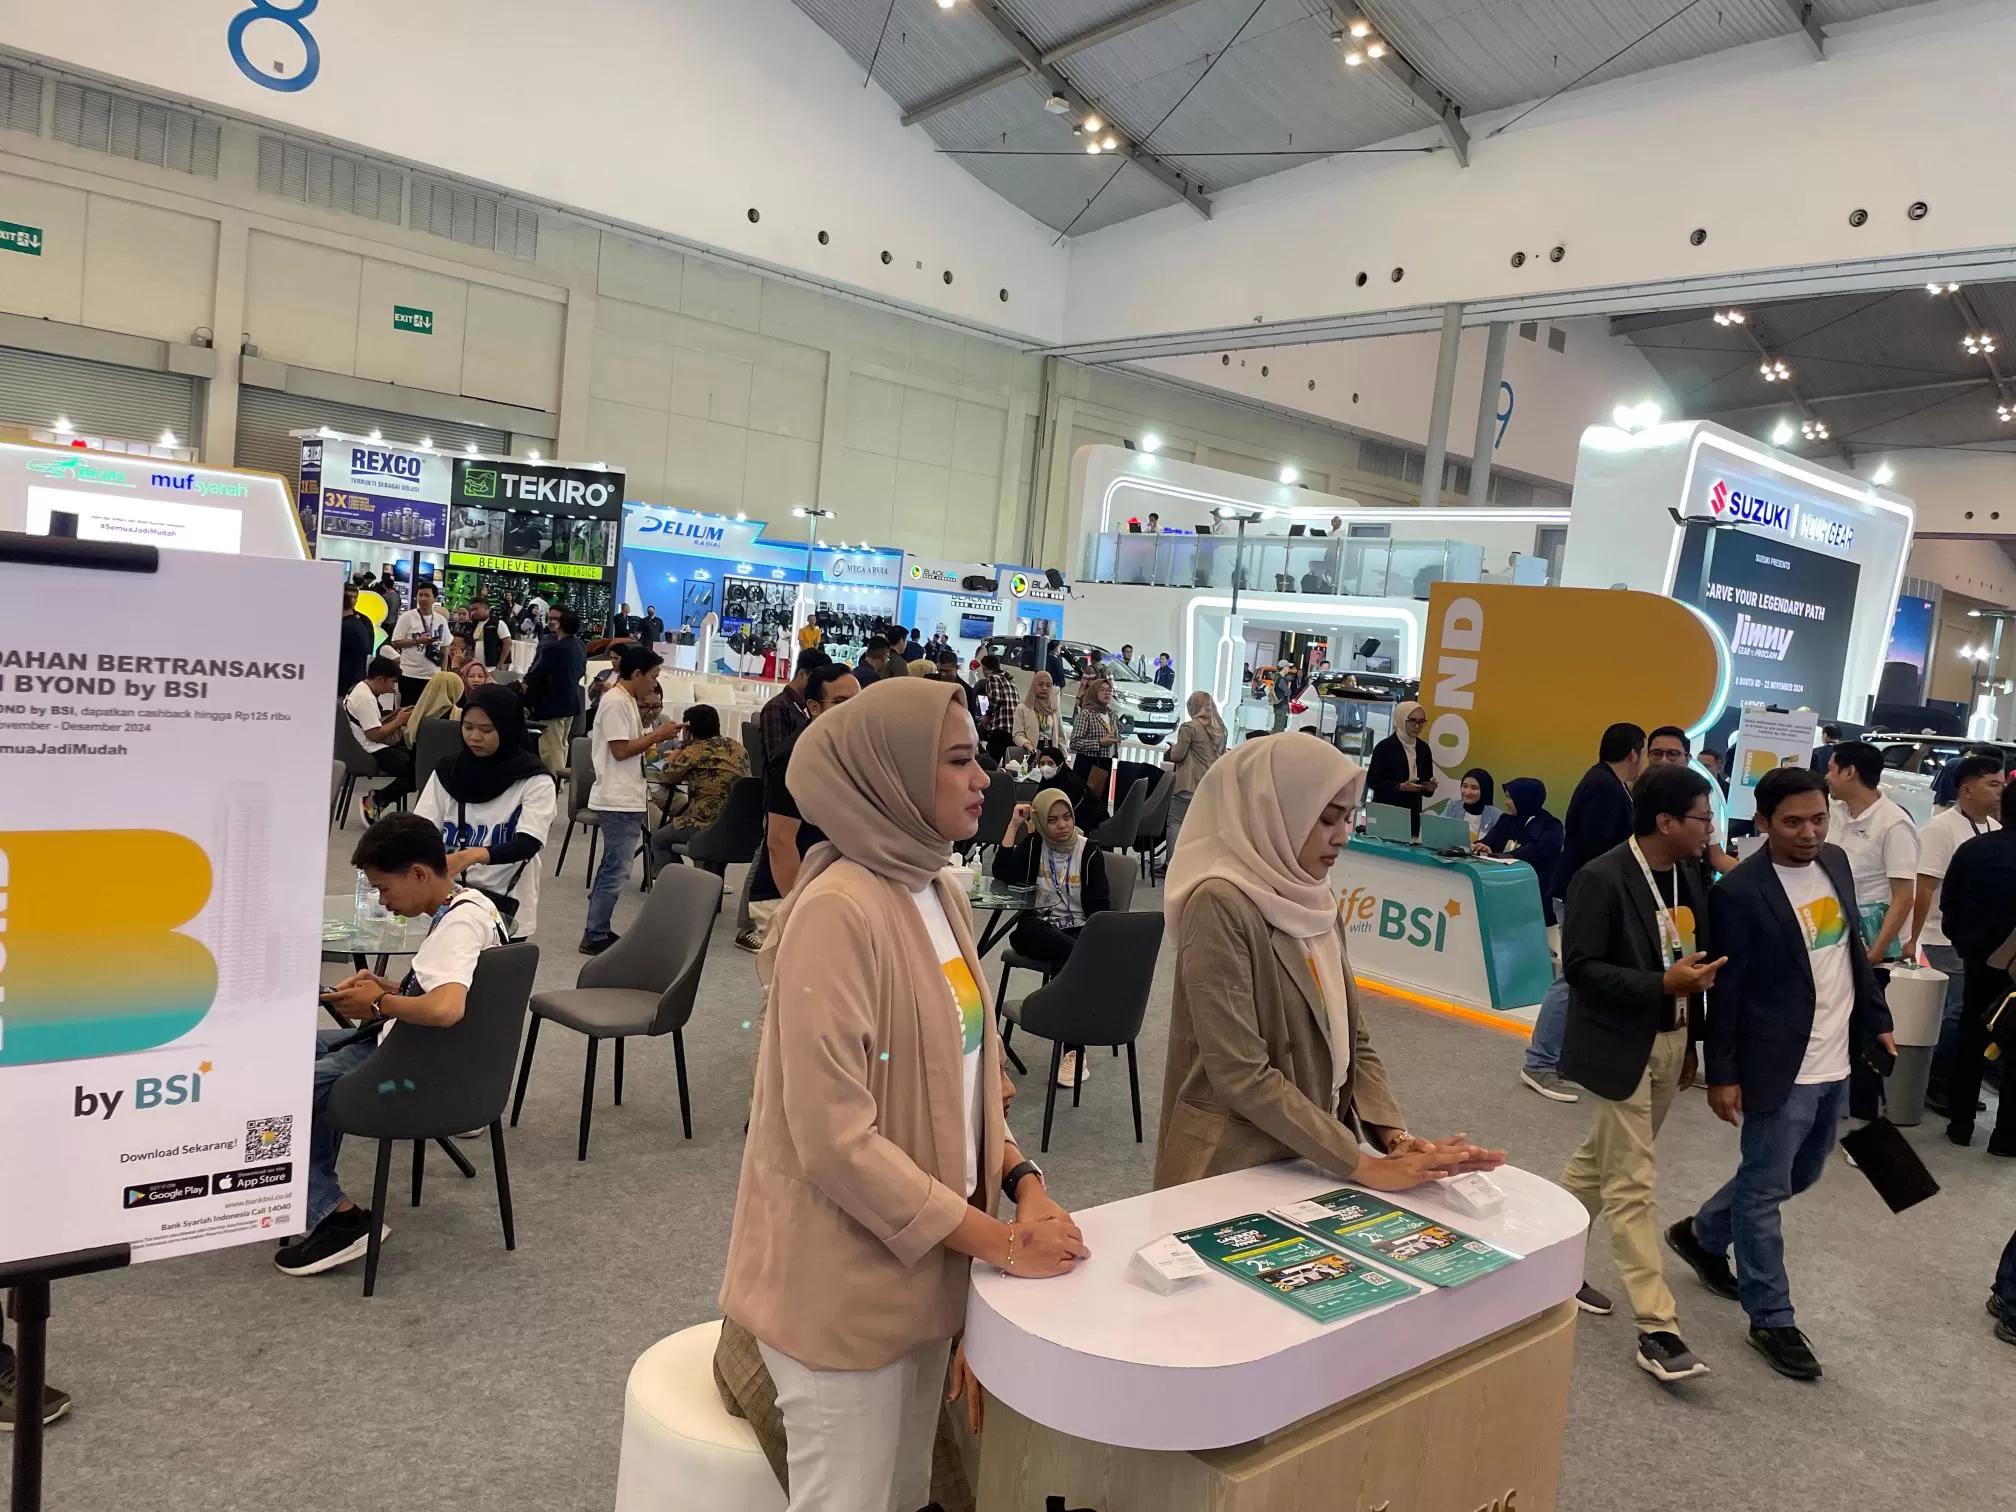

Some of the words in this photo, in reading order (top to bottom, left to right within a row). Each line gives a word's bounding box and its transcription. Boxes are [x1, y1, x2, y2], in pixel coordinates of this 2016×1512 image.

[395, 314, 413, 324] EXIT
[351, 448, 420, 477] REXCO
[351, 477, 377, 487] TERBUKTI
[378, 481, 401, 490] SEBAGAI
[325, 492, 347, 508] 3X
[1729, 491, 1791, 530] SUZUKI
[639, 516, 724, 540] DELIUM
[479, 557, 529, 571] BELIEVE
[536, 564, 547, 574] IN
[553, 566, 571, 576] YOUR
[573, 567, 596, 578] CHOICE
[847, 564, 866, 574] MEGA
[1734, 587, 1757, 607] YOUR
[1758, 593, 1804, 617] LEGENDARY
[1804, 603, 1826, 621] PATH
[97, 654, 305, 680] BERTRANSAKSI
[15, 674, 116, 696] BYOND
[125, 679, 157, 701] by
[164, 680, 208, 699] BSI
[30, 705, 47, 717] by
[81, 707, 135, 718] dapatkan
[137, 709, 191, 719] cashback
[194, 710, 232, 721] hingga
[235, 711, 268, 722] Rp125
[270, 712, 291, 721] ribu
[61, 721, 122, 732] Desember
[124, 723, 152, 732] 2024
[1349, 921, 1371, 933] with
[1379, 898, 1447, 952] BSI
[74, 1085, 123, 1120] by
[135, 1072, 201, 1111] BSI
[120, 1146, 179, 1163] Download
[182, 1138, 238, 1154] Sekarang!
[237, 1178, 258, 1188] App
[259, 1173, 286, 1184] Store
[149, 1189, 183, 1200] Google
[184, 1186, 204, 1195] Play
[161, 1222, 181, 1231] Bank
[183, 1217, 212, 1229] Syariah
[213, 1211, 250, 1223] Indonesia
[251, 1207, 266, 1216] Call
[268, 1202, 292, 1213] 14040
